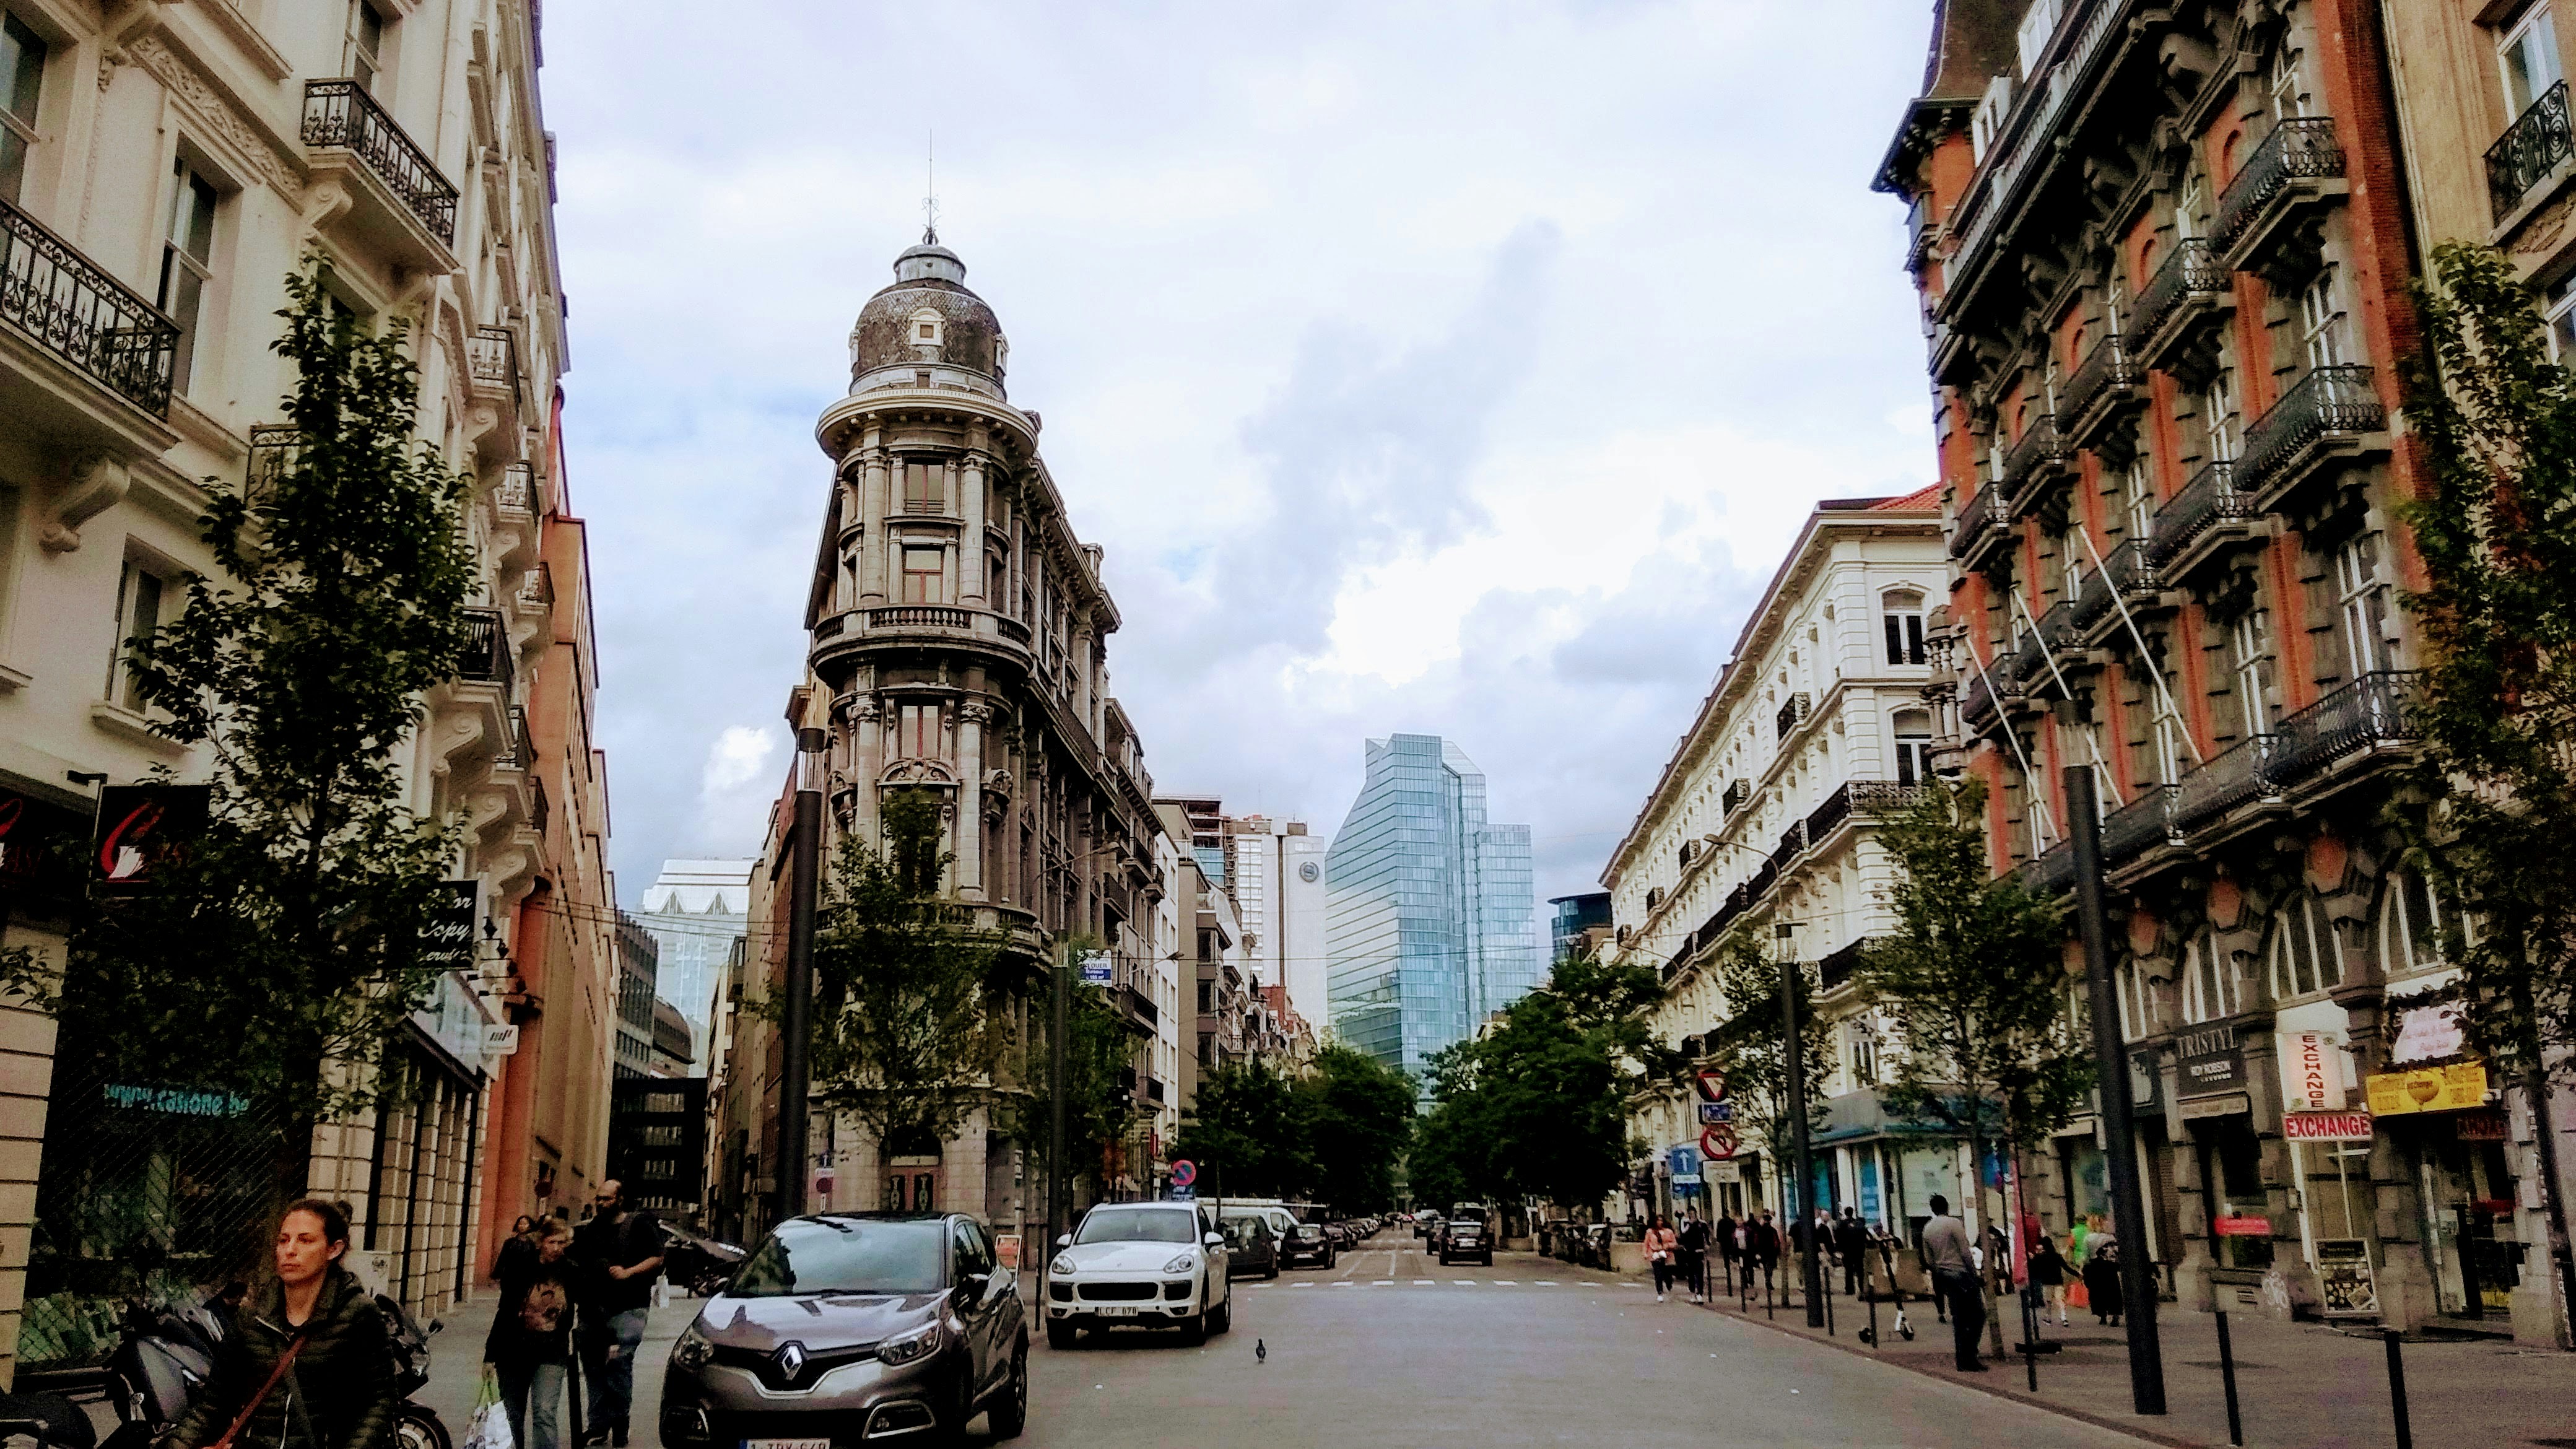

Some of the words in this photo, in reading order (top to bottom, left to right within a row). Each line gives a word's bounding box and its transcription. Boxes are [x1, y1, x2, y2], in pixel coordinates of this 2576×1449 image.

[2178, 1026, 2239, 1059] TRISTYL
[2301, 1034, 2325, 1108] EXCHANGE
[2286, 1115, 2371, 1138] EXCHANGE
